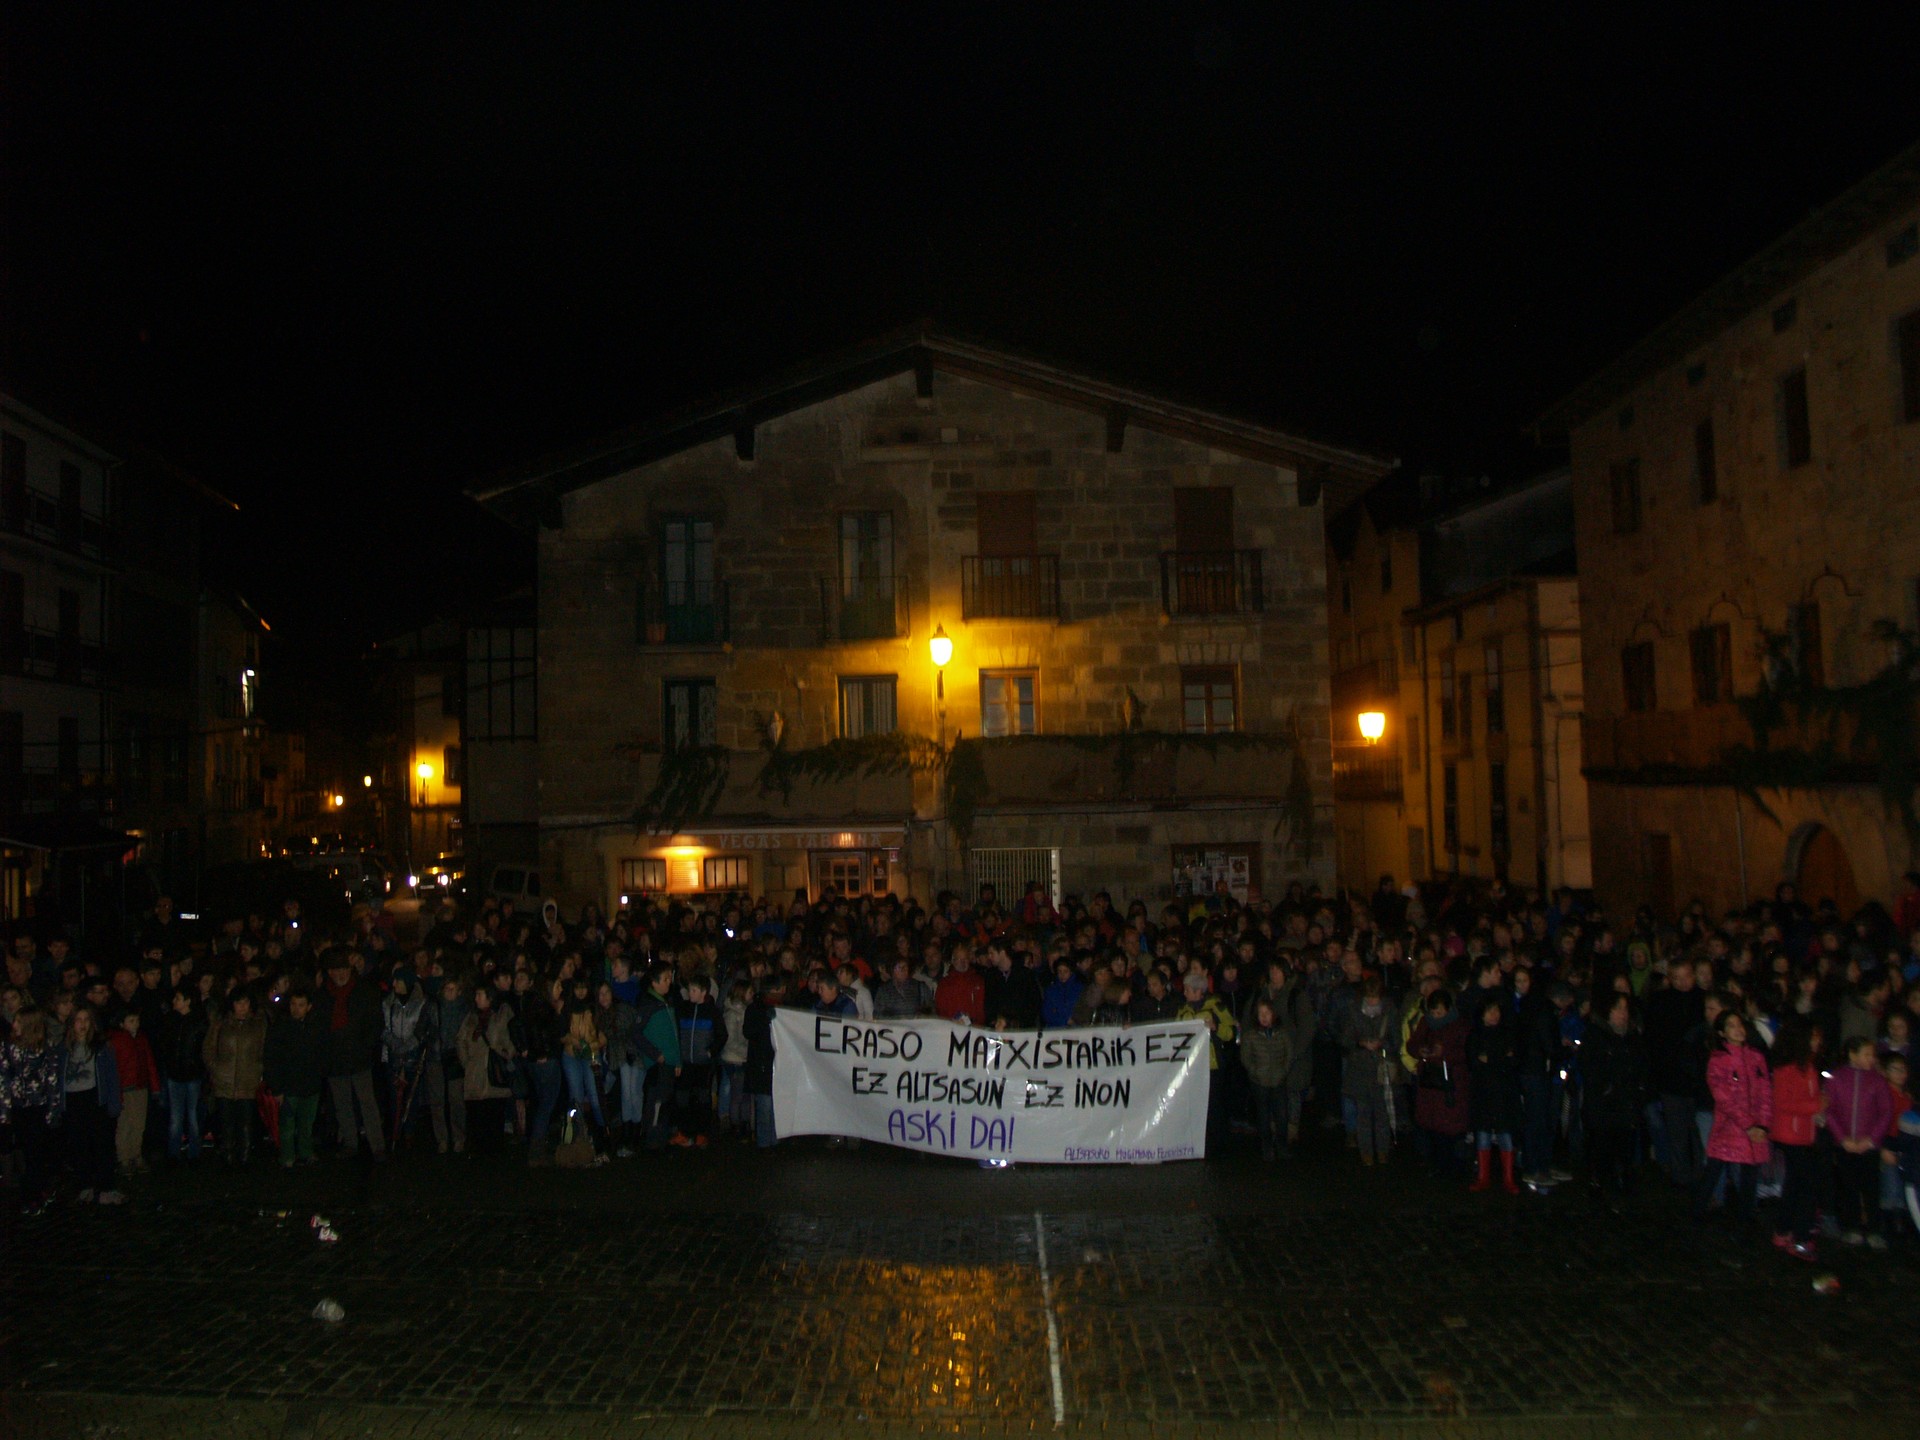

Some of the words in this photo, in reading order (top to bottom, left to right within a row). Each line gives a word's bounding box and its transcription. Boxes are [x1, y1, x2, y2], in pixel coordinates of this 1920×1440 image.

[719, 833, 781, 849] VEGAS
[795, 833, 881, 848] TABNA
[815, 1015, 923, 1062] ERASO
[1145, 1033, 1196, 1063] EZ
[851, 1067, 888, 1095] EZ
[897, 1070, 1007, 1109] ALTSASUN
[1025, 1078, 1064, 1108] EZ
[970, 1115, 1015, 1153] DA!
